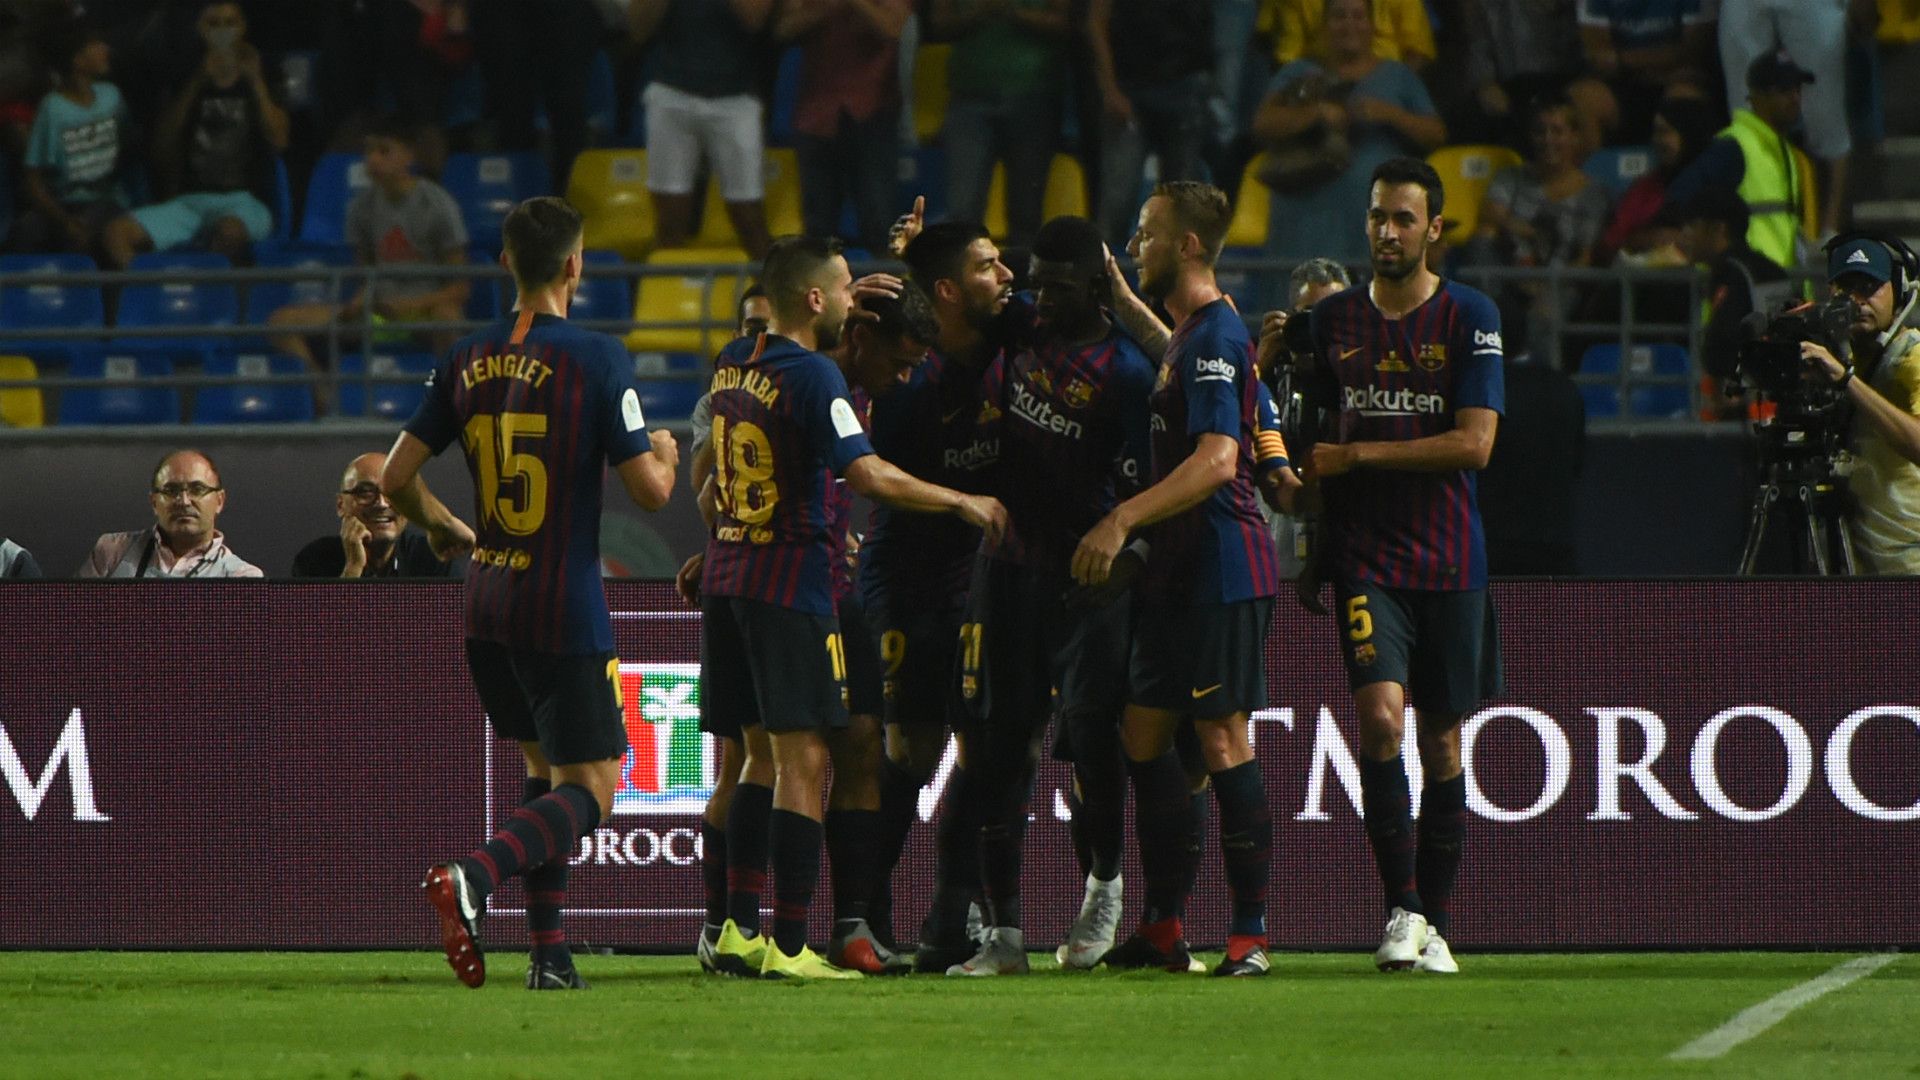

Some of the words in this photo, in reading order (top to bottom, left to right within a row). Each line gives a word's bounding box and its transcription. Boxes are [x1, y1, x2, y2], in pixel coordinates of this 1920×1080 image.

[461, 353, 553, 391] LENGLET
[710, 366, 741, 395] ORDI
[740, 368, 780, 410] ALBA
[1196, 357, 1236, 379] beko
[1011, 381, 1083, 440] kuten
[1344, 384, 1444, 414] Rakuten
[463, 411, 549, 536] 15
[712, 413, 780, 526] 18
[1346, 593, 1374, 642] 5
[880, 629, 907, 677] 9
[959, 622, 984, 672] 11
